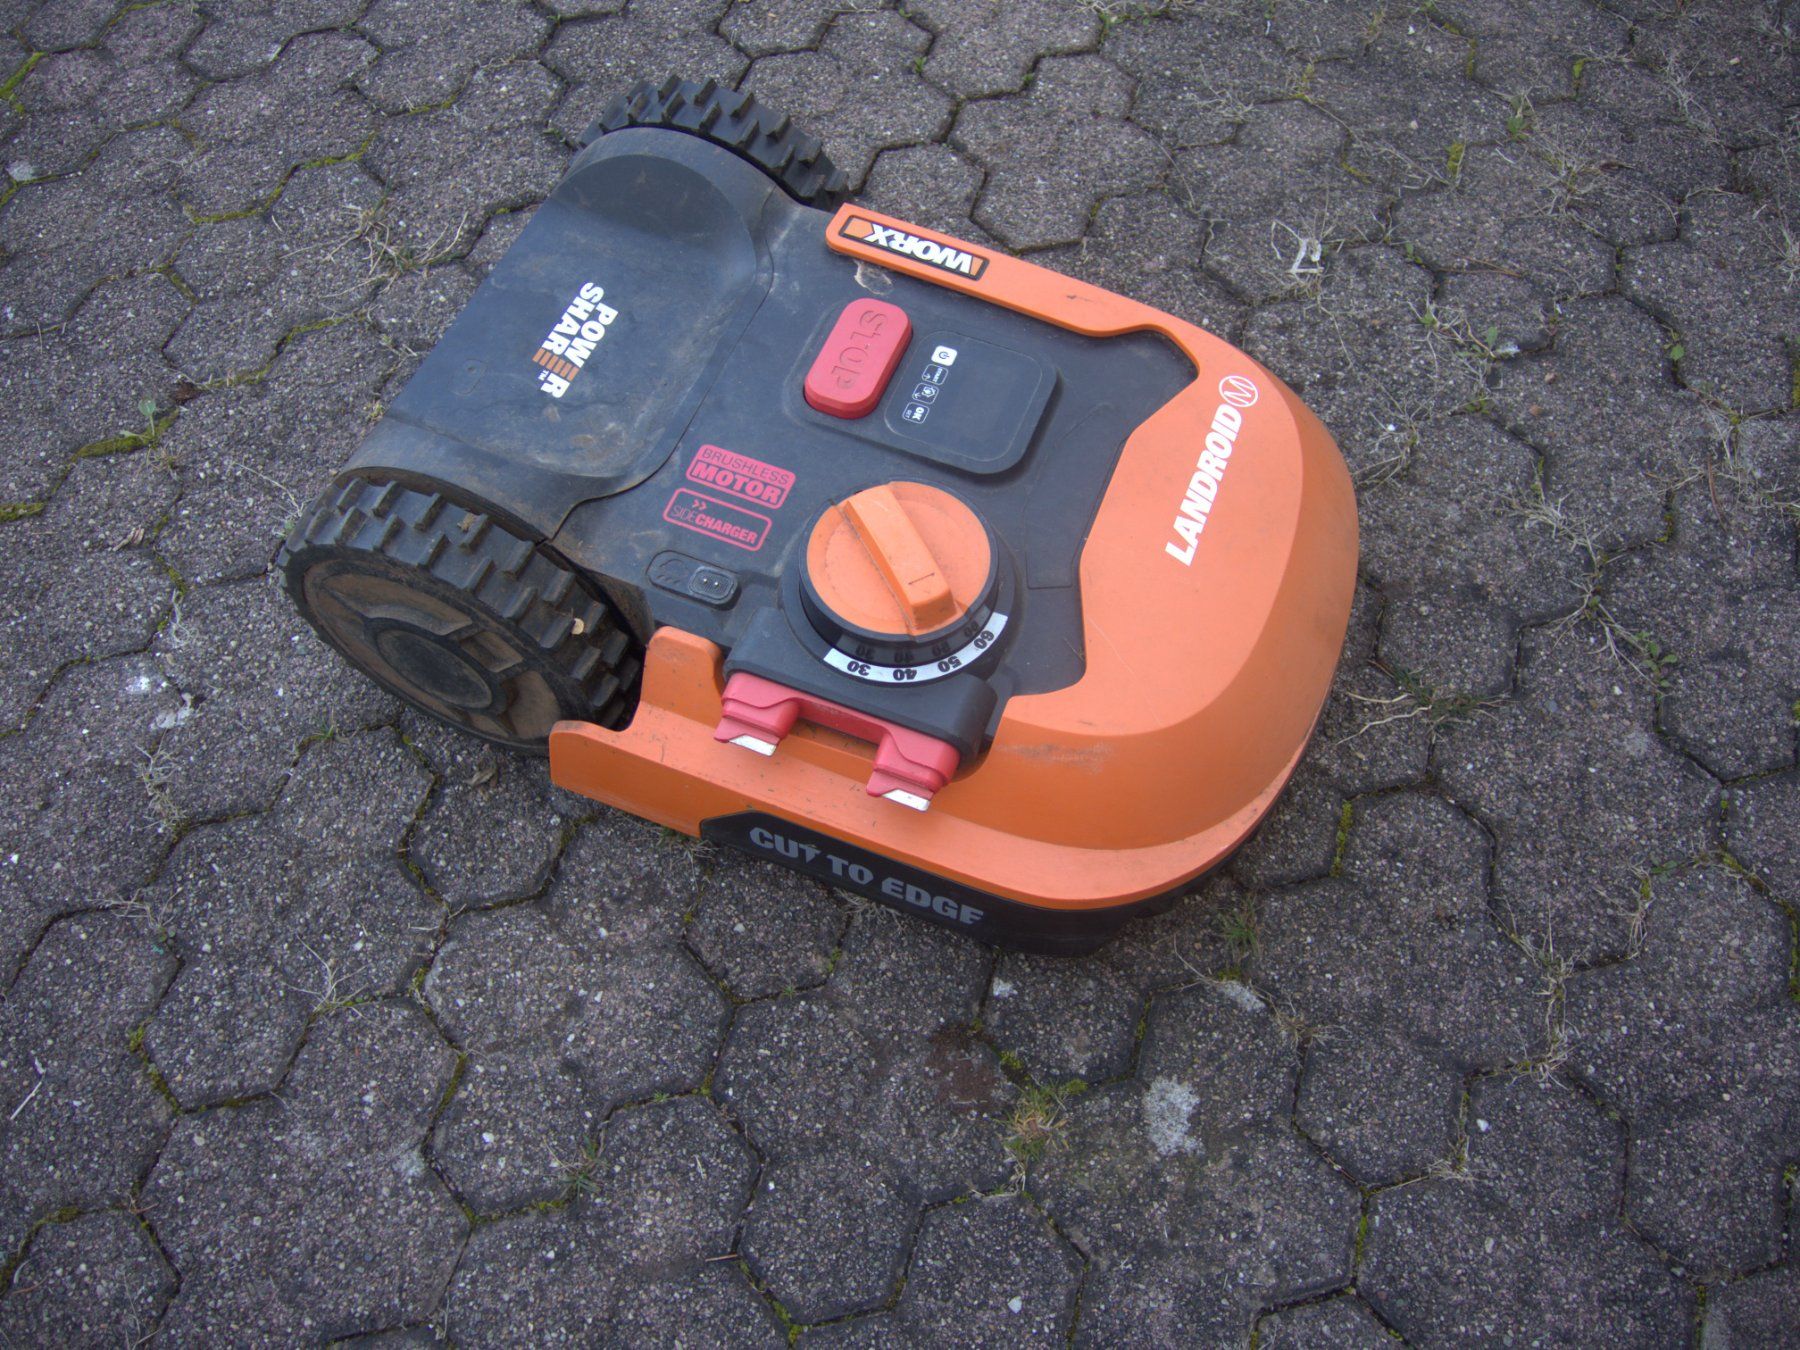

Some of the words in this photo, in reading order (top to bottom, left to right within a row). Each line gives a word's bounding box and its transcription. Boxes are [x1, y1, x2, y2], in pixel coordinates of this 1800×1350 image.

[864, 223, 973, 273] WORX
[831, 310, 888, 390] STOP
[912, 407, 925, 421] OK
[692, 463, 782, 504] MOTOR
[702, 448, 790, 485] BRUSHLESS
[1165, 403, 1242, 566] LANDROID
[847, 660, 872, 676] 30
[892, 668, 918, 681] 40
[937, 655, 963, 673] 50
[973, 630, 995, 650] 60
[750, 827, 821, 864] CUT
[826, 854, 874, 885] TO
